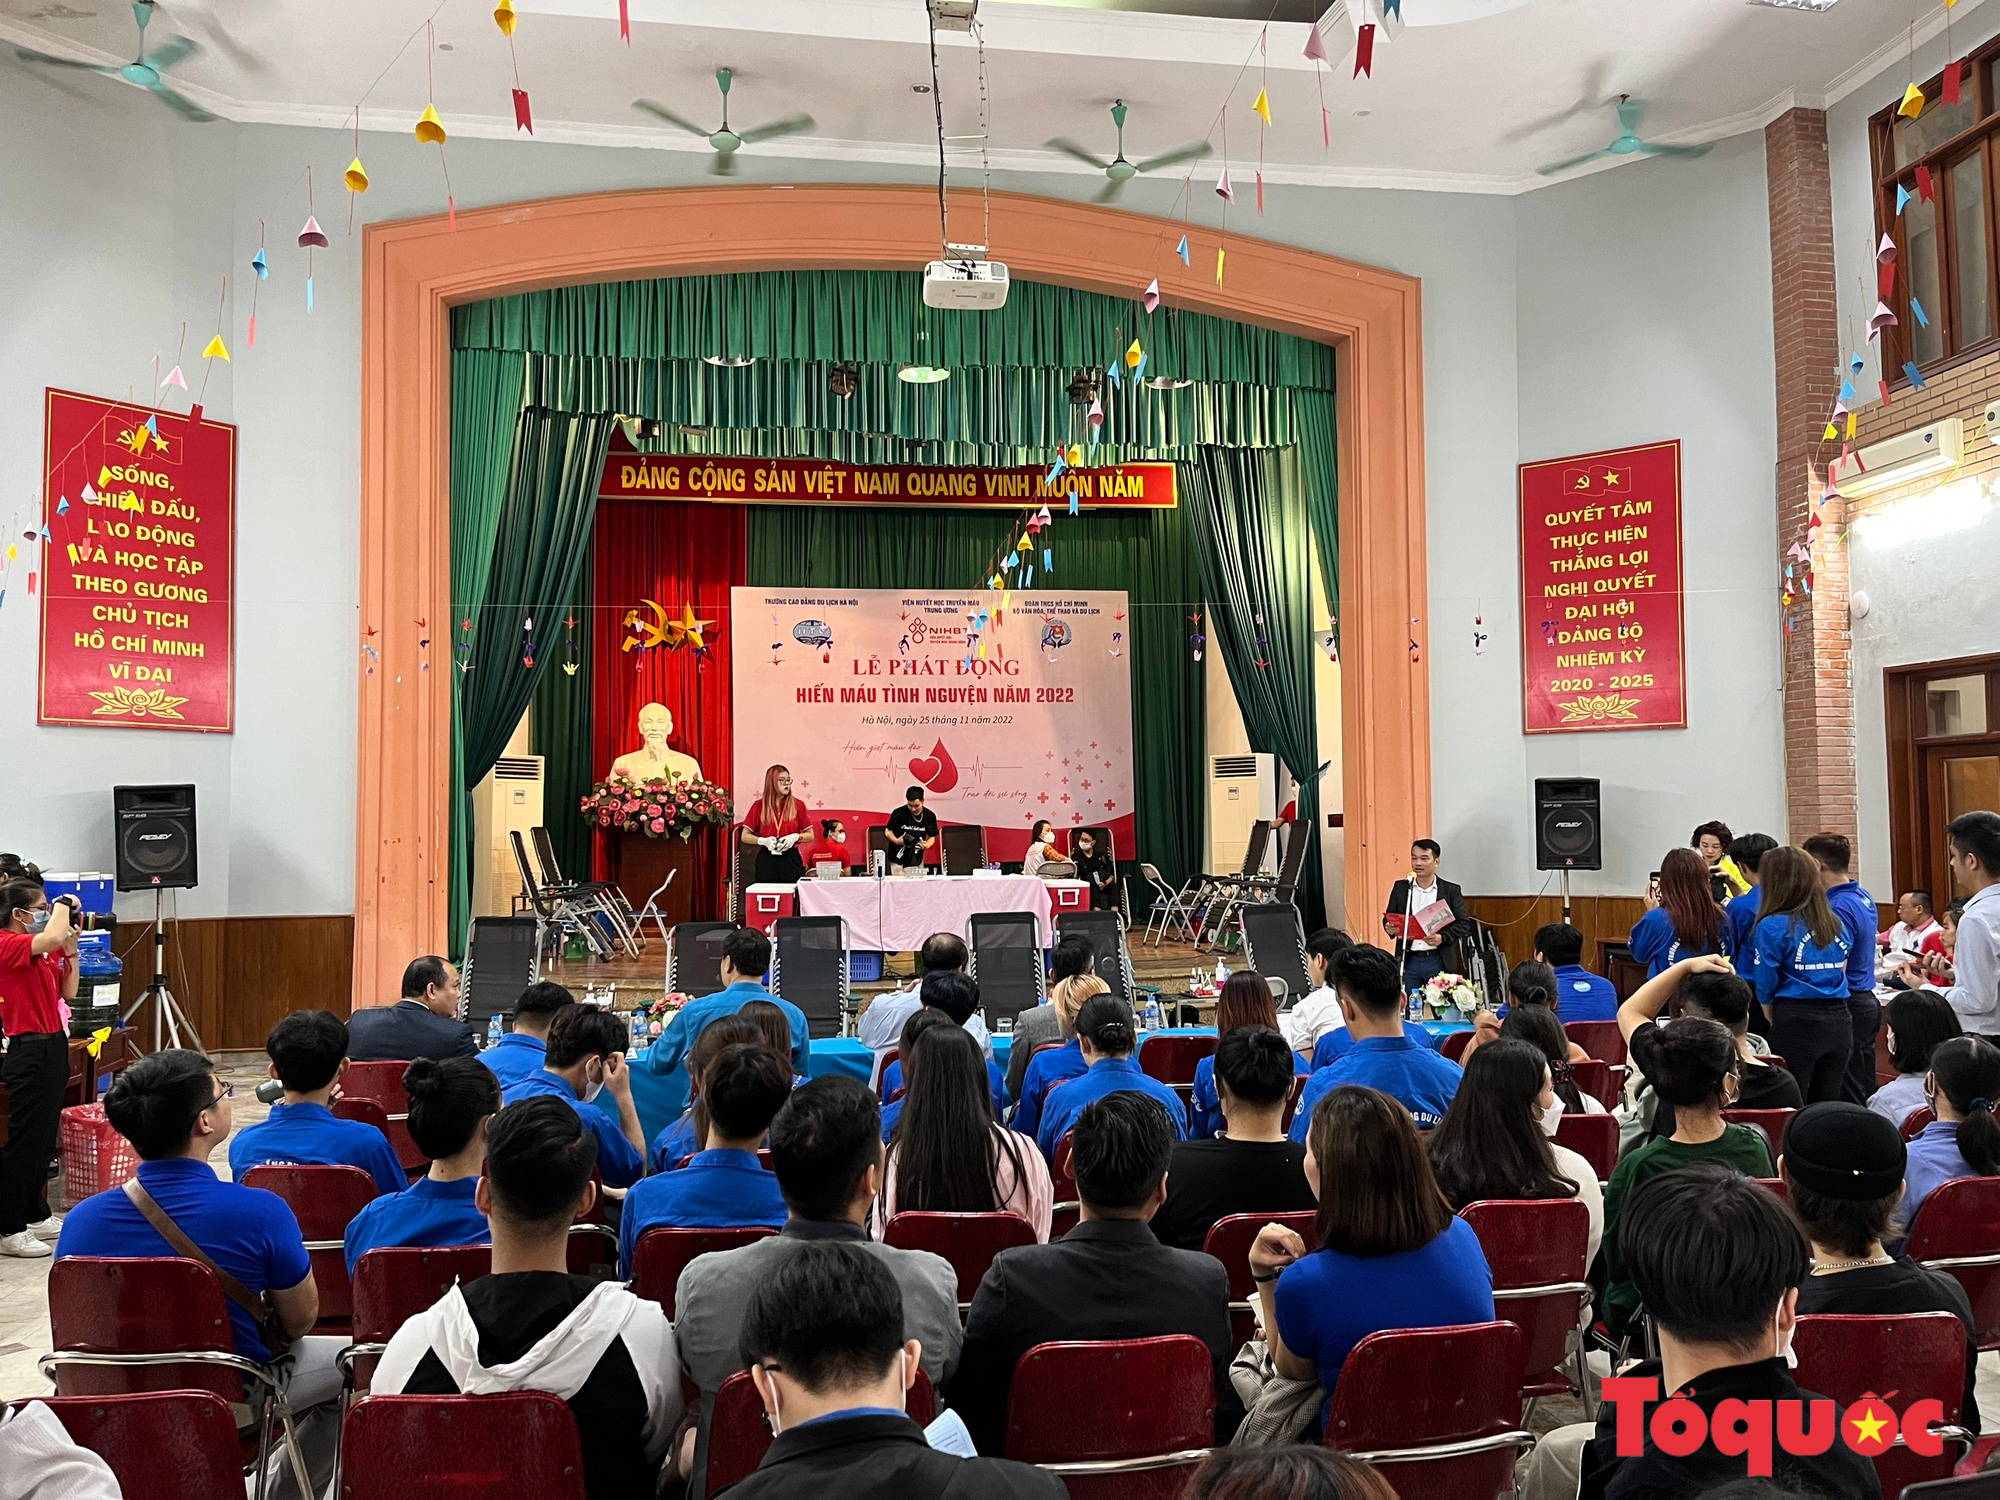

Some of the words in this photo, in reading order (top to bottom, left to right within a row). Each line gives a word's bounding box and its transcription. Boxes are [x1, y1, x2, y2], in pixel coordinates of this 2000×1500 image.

[111, 463, 175, 492] SỐNG,
[620, 457, 680, 489] ĐẢNG
[688, 461, 746, 498] CỘNG
[753, 460, 796, 493] SẢN
[804, 464, 847, 500] VIỆT
[854, 472, 900, 495] NAM
[907, 473, 977, 497] QUANG
[984, 474, 1030, 497] VINH
[1036, 469, 1093, 498] MUÔN
[1099, 469, 1144, 498] NĂM
[151, 498, 200, 523] ĐẤU,
[1545, 504, 1605, 527] QUYẾT
[1611, 500, 1652, 518] TÂM
[136, 525, 195, 547] ĐỘNG
[1550, 531, 1598, 551] THỰC
[1605, 525, 1648, 545] HIỆN
[115, 551, 158, 573] HỌC
[164, 556, 204, 578] TẬP
[1550, 551, 1613, 573] THẮNG
[1619, 550, 1649, 569] LỢI
[72, 574, 127, 595] THEO
[134, 581, 208, 604] GƯƠNG
[1544, 582, 1588, 598] NGHỊ
[1594, 570, 1656, 593] QUYẾT
[92, 602, 137, 624] CHỦ
[143, 610, 189, 631] TỊCH
[1565, 604, 1597, 621] ĐẠI
[74, 628, 105, 649] HỒ
[111, 634, 146, 653] CHÍ
[153, 640, 204, 658] MINH
[1558, 624, 1612, 644] ĐẢNG
[1618, 622, 1643, 644] BỘ
[852, 654, 882, 676] LỄ
[889, 655, 950, 676] PHÁT
[955, 655, 1020, 680] ĐỘNG
[1556, 651, 1614, 670] NHIỆM
[1621, 649, 1646, 664] KỲ
[109, 661, 131, 679] VĨ
[135, 666, 172, 687] ĐẠI
[1551, 678, 1593, 692] 2020
[1610, 674, 1654, 688] 2025
[796, 682, 834, 704] HIẾN
[841, 684, 876, 703] MÁU
[882, 684, 919, 703] TÌNH
[926, 684, 987, 705] NGUYỆN
[994, 684, 1031, 703] NĂM
[1037, 687, 1074, 703] 2022
[862, 715, 874, 725] Hà
[876, 715, 894, 726] Nội,
[896, 715, 918, 727] ngày
[919, 715, 930, 725] 25
[932, 715, 957, 727] tháng
[959, 715, 969, 725] 11
[971, 715, 991, 725] năm
[993, 715, 1013, 725] 2022
[1421, 1111, 1432, 1122] DU
